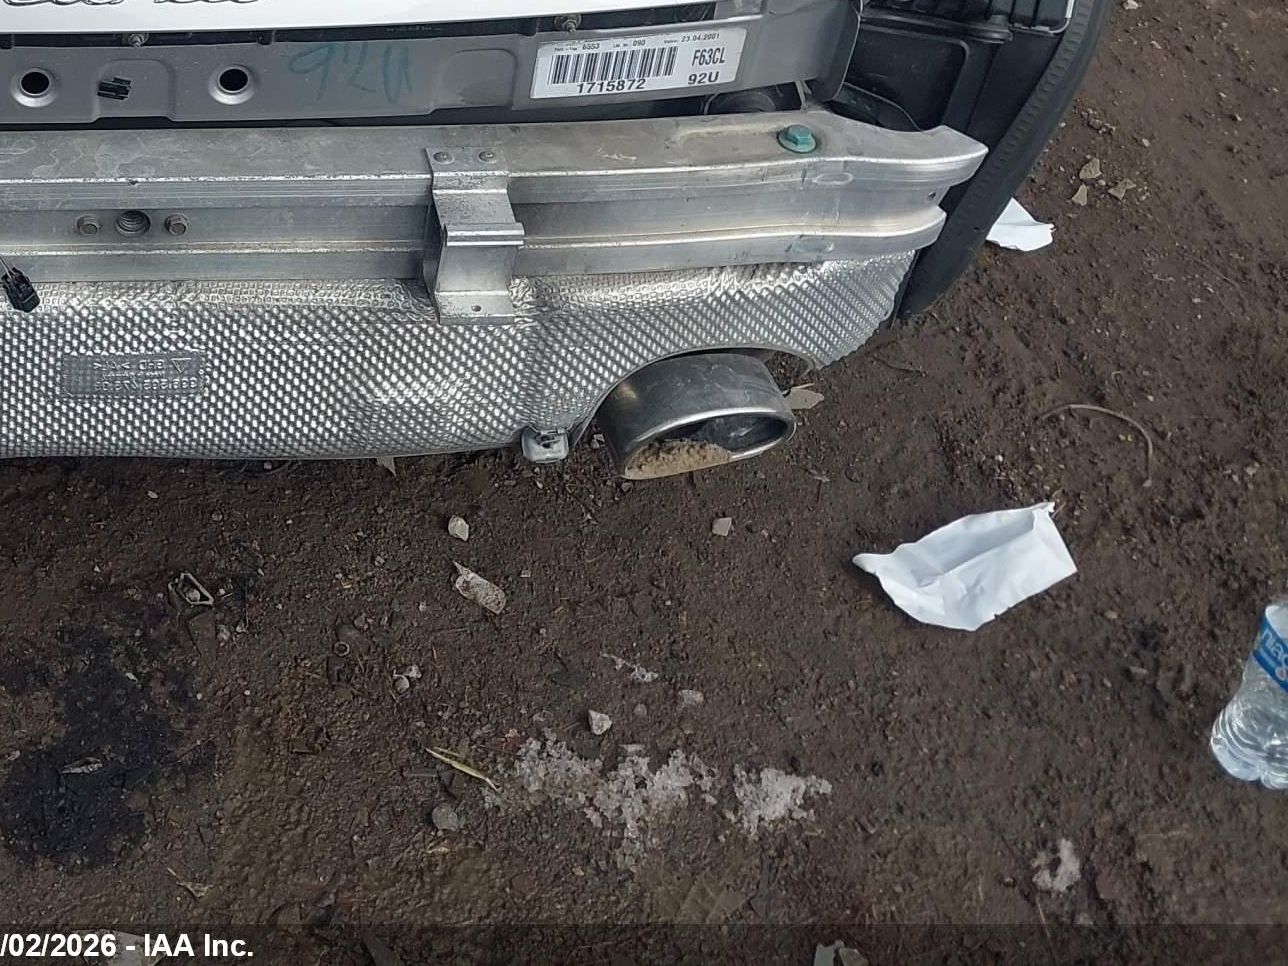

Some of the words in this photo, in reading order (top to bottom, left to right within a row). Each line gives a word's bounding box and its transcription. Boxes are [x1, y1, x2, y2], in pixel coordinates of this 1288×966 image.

[680, 32, 720, 43] 23.04.2001
[691, 47, 726, 66] F63CL
[577, 79, 646, 94] 1715872
[687, 71, 720, 85] 92U
